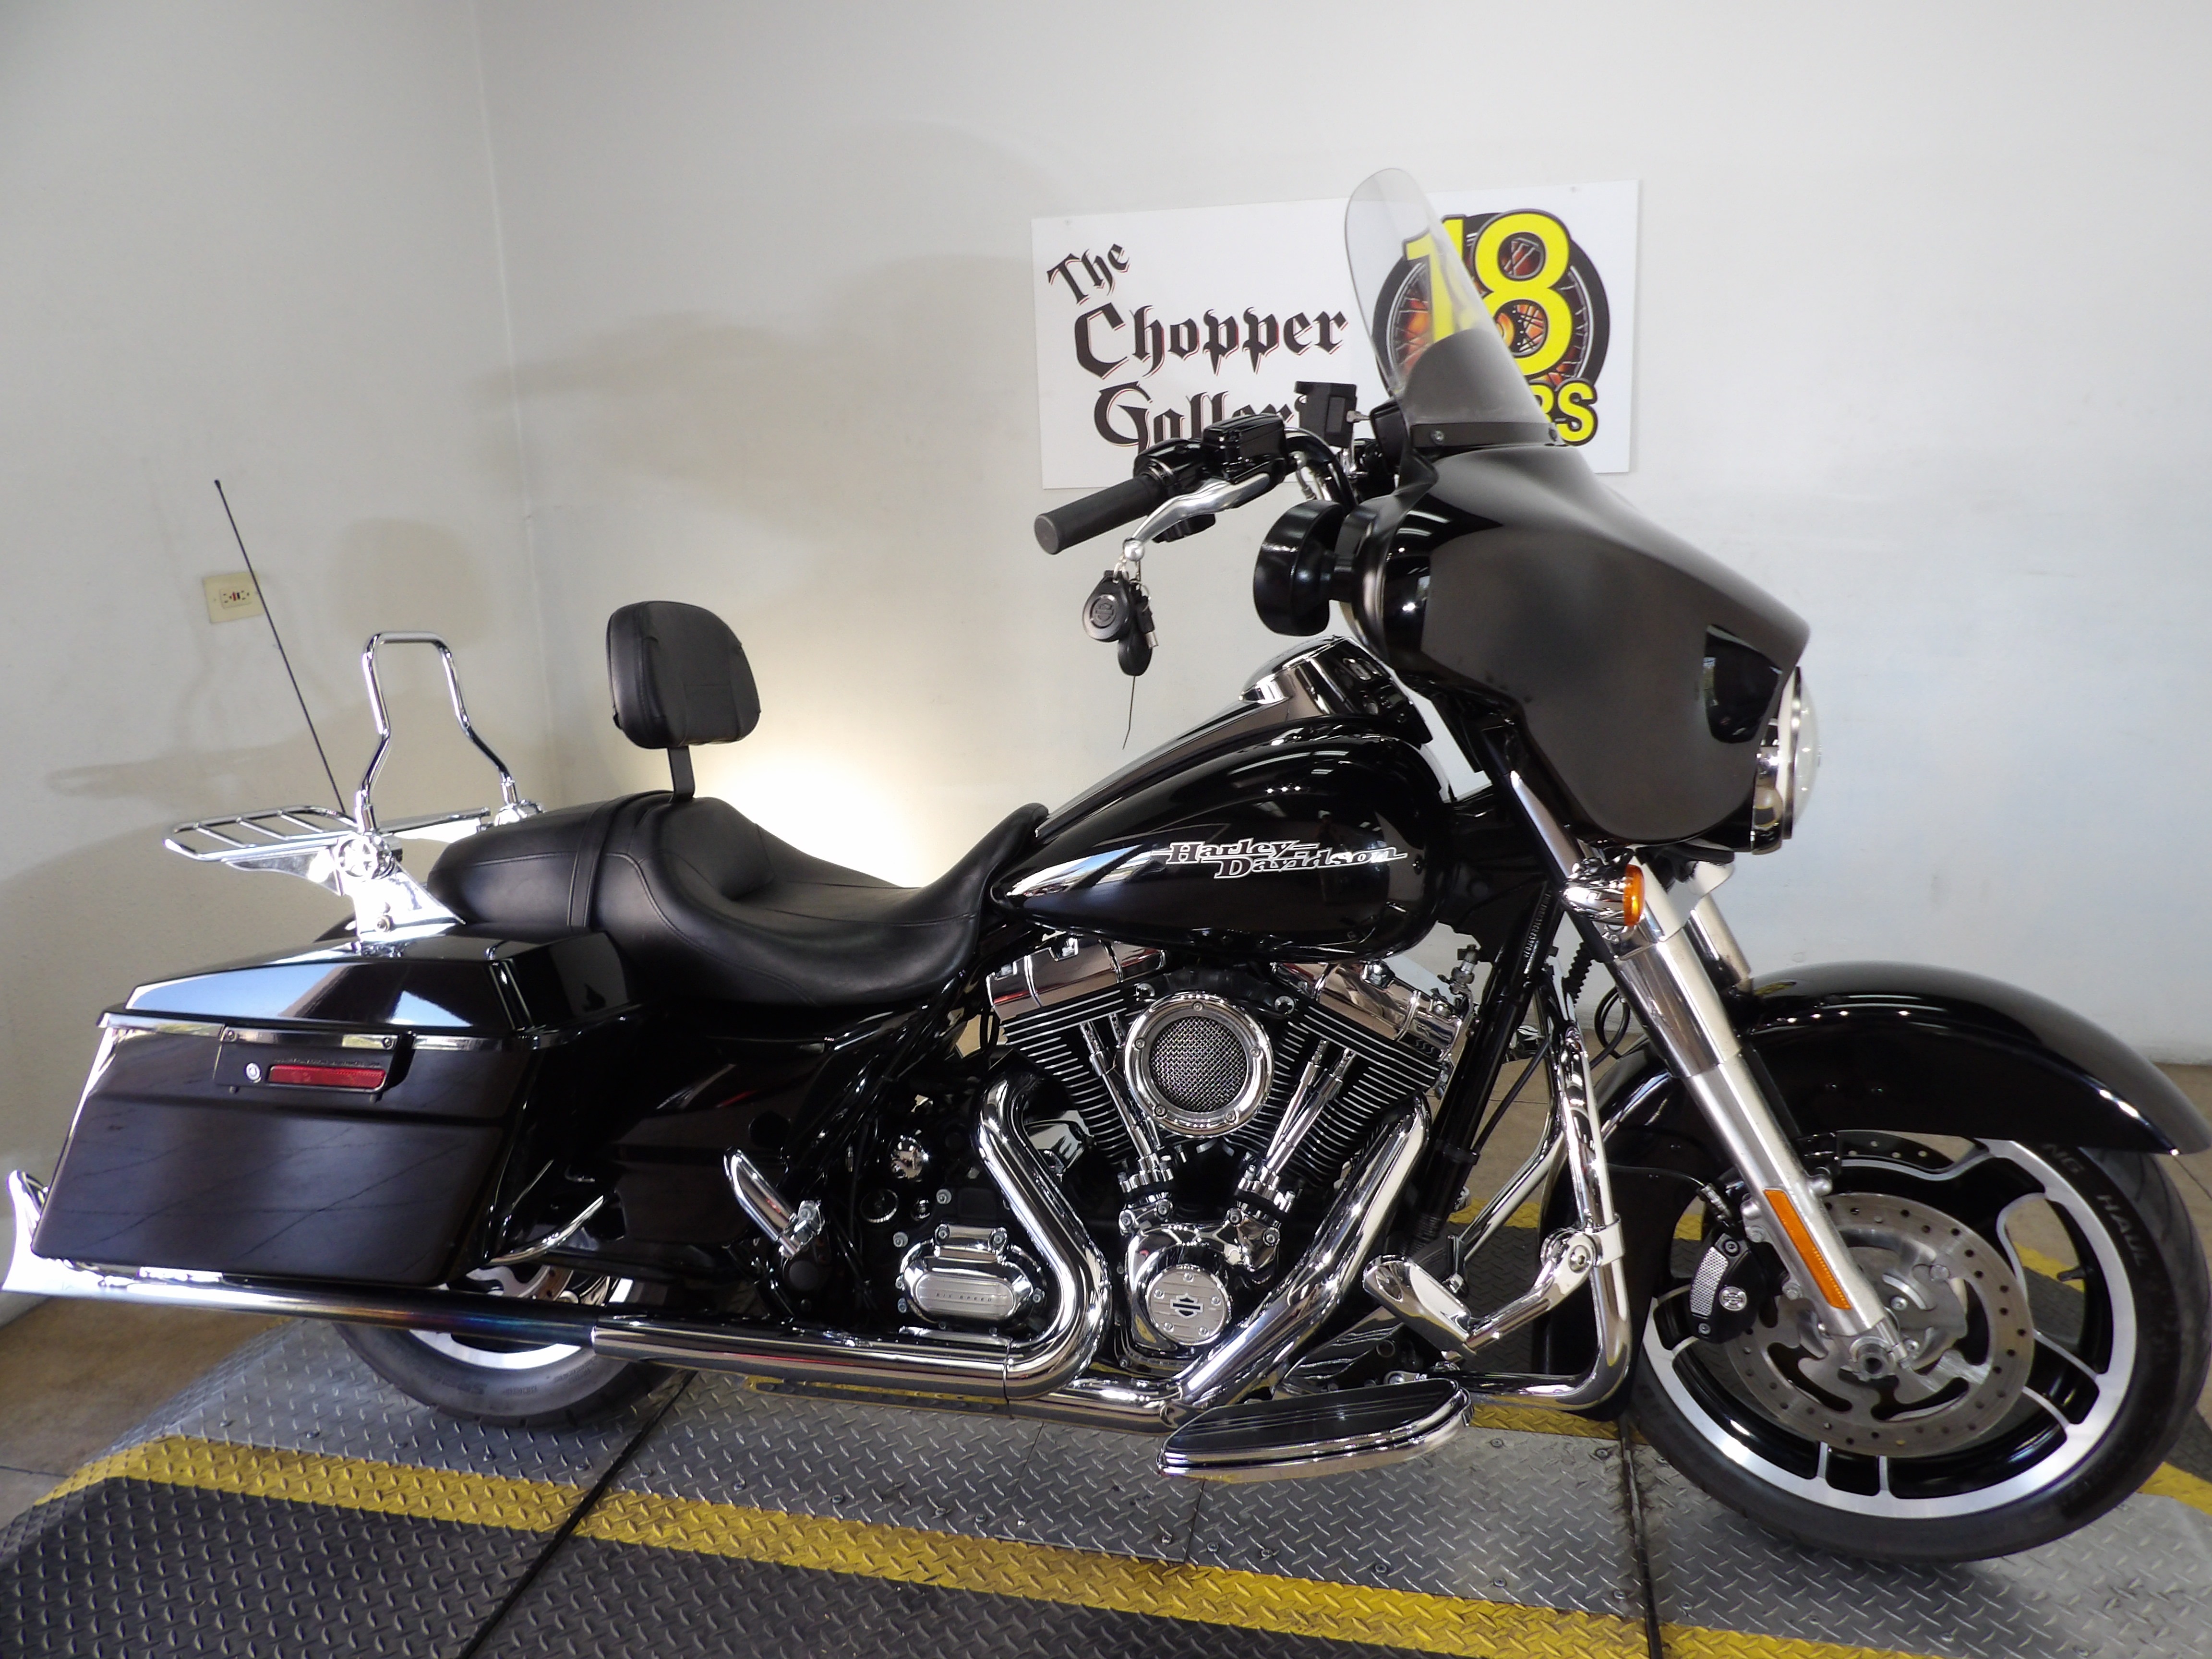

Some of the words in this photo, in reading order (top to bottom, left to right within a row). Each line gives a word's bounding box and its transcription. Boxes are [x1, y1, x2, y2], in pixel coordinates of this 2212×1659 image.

[1046, 243, 1130, 306] The
[1403, 209, 1573, 376] 18
[1074, 302, 1348, 380] Chopper
[1094, 381, 1307, 456] Gall
[1213, 847, 1407, 879] Davidson
[2040, 1143, 2086, 1173] NG
[2096, 1194, 2150, 1267] HAUL
